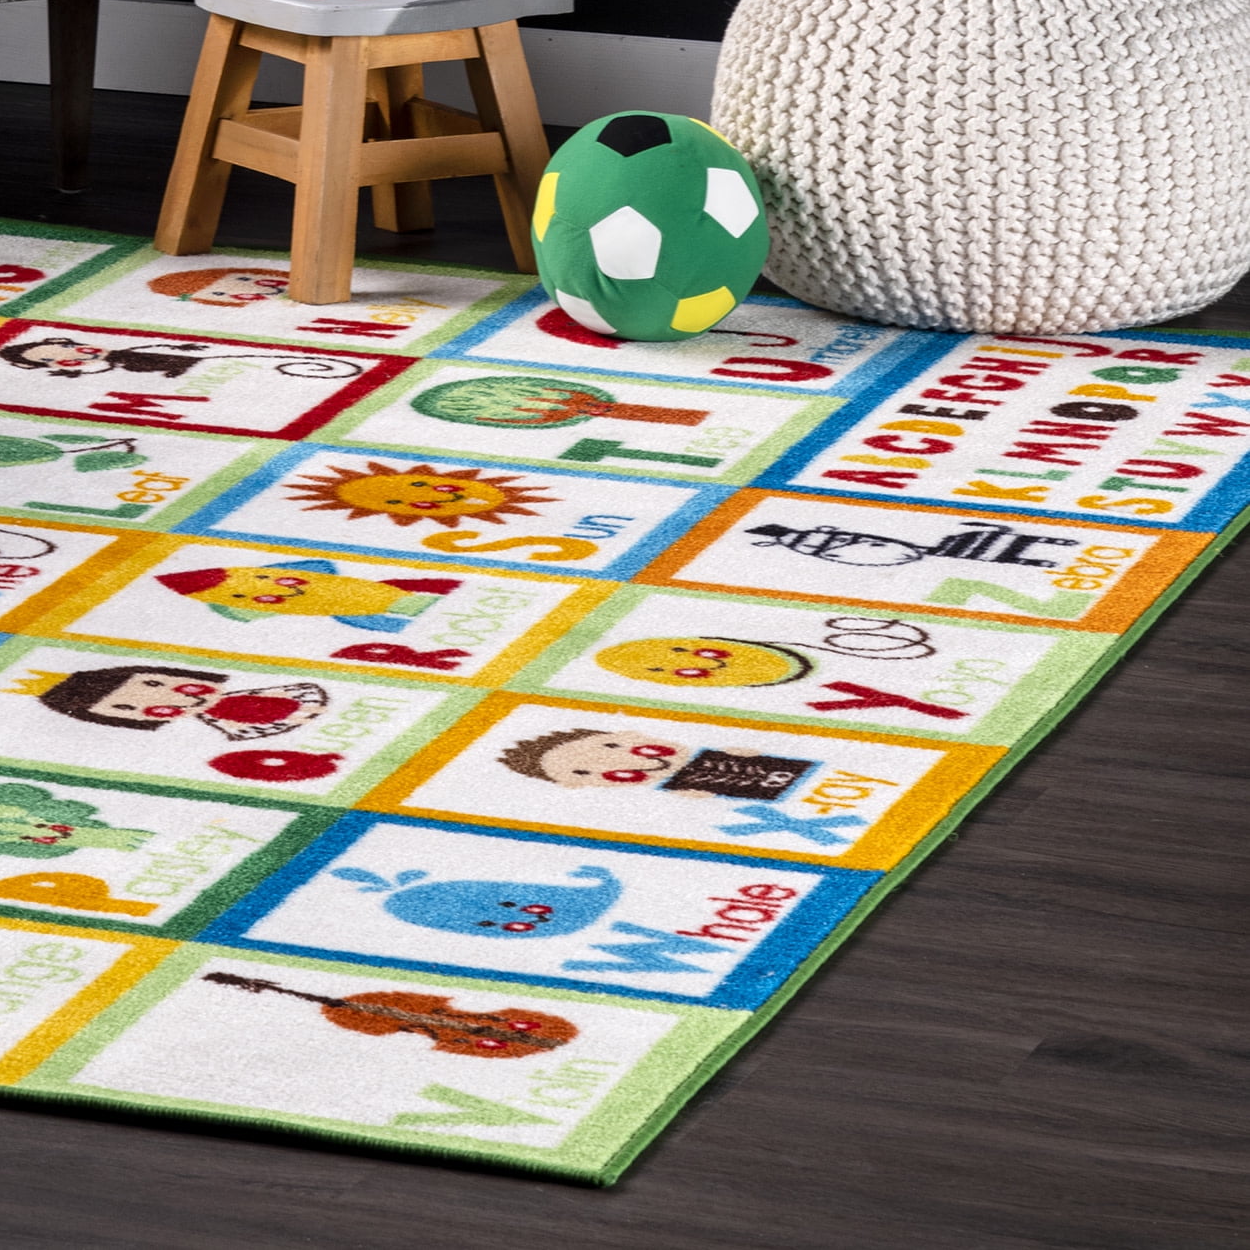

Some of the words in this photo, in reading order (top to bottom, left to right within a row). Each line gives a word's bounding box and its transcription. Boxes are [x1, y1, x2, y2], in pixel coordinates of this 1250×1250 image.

[22, 470, 190, 522] Leaf
[422, 514, 635, 561] Sun
[922, 544, 1136, 621] Zebra
[329, 586, 531, 670] Rocket
[207, 696, 410, 782] Queen
[561, 883, 798, 974] Whale
